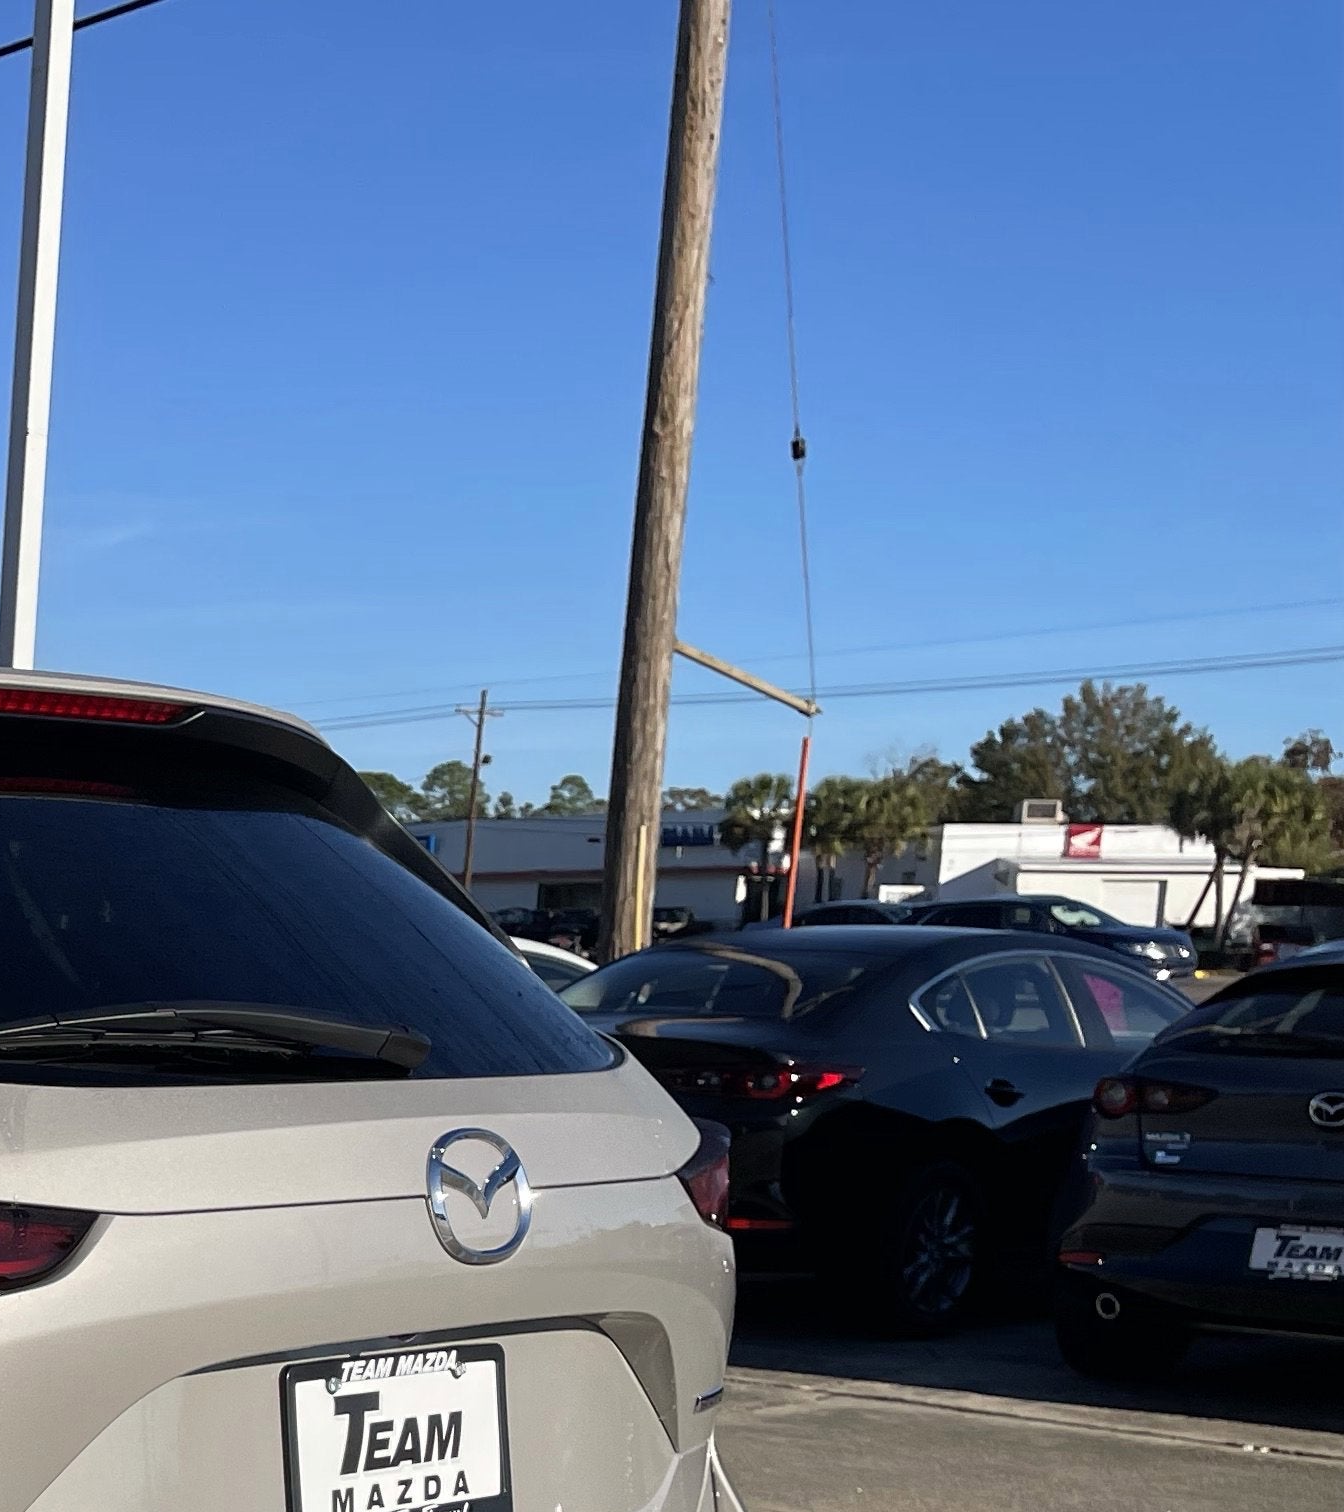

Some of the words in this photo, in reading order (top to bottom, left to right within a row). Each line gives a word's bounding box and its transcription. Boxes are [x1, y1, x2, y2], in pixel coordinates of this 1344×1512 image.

[1273, 1235, 1343, 1261] TEAM
[341, 1355, 395, 1382] TEAM
[395, 1350, 459, 1377] MAZDA
[333, 1391, 463, 1476] TEAM
